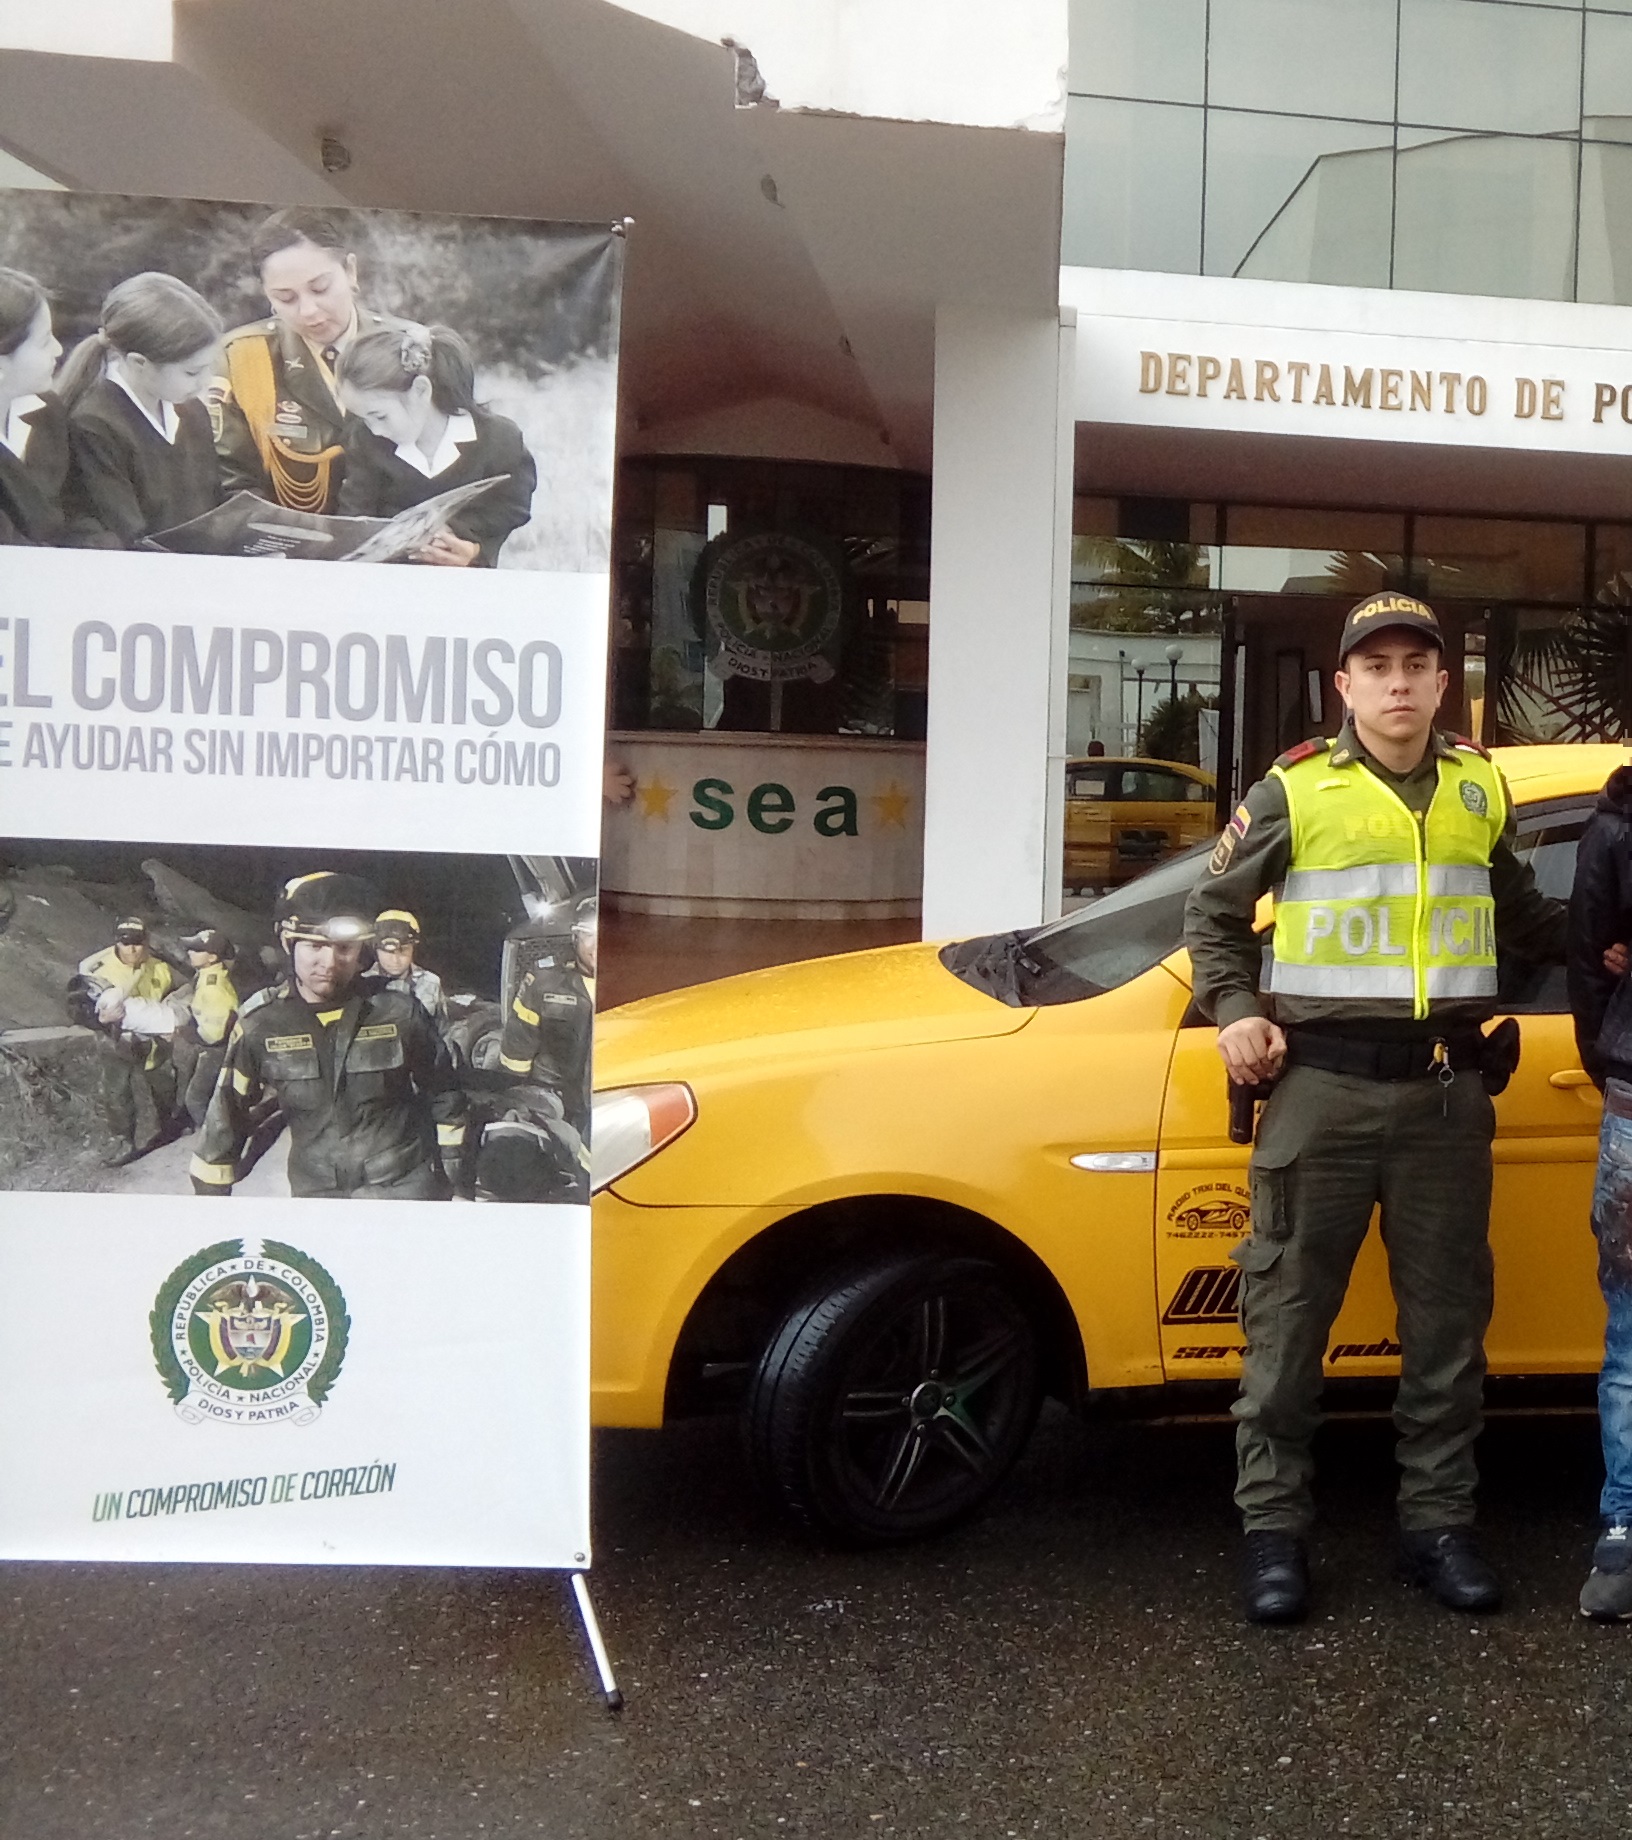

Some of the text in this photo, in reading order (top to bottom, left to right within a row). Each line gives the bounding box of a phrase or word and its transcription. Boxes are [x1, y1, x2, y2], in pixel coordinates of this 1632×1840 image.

[1138, 351, 1487, 416] DEPARTAMENTO
[1514, 377, 1565, 420] DE
[1353, 598, 1432, 625] POLICIA
[0, 617, 562, 729] L COMPROMISO
[22, 722, 173, 774] AYUDAR
[183, 728, 244, 776] SIN
[256, 731, 444, 783] IMPORTAR
[454, 732, 561, 788] CÓMO
[689, 778, 859, 837] sea
[244, 1260, 264, 1270] DE
[281, 1269, 325, 1343] COLOMBIA
[198, 1399, 300, 1421] DIOS Y PATRIA
[250, 1362, 318, 1403] NACIONAL
[93, 1458, 396, 1522] UN COMPROMISO DE CORAZÓN
